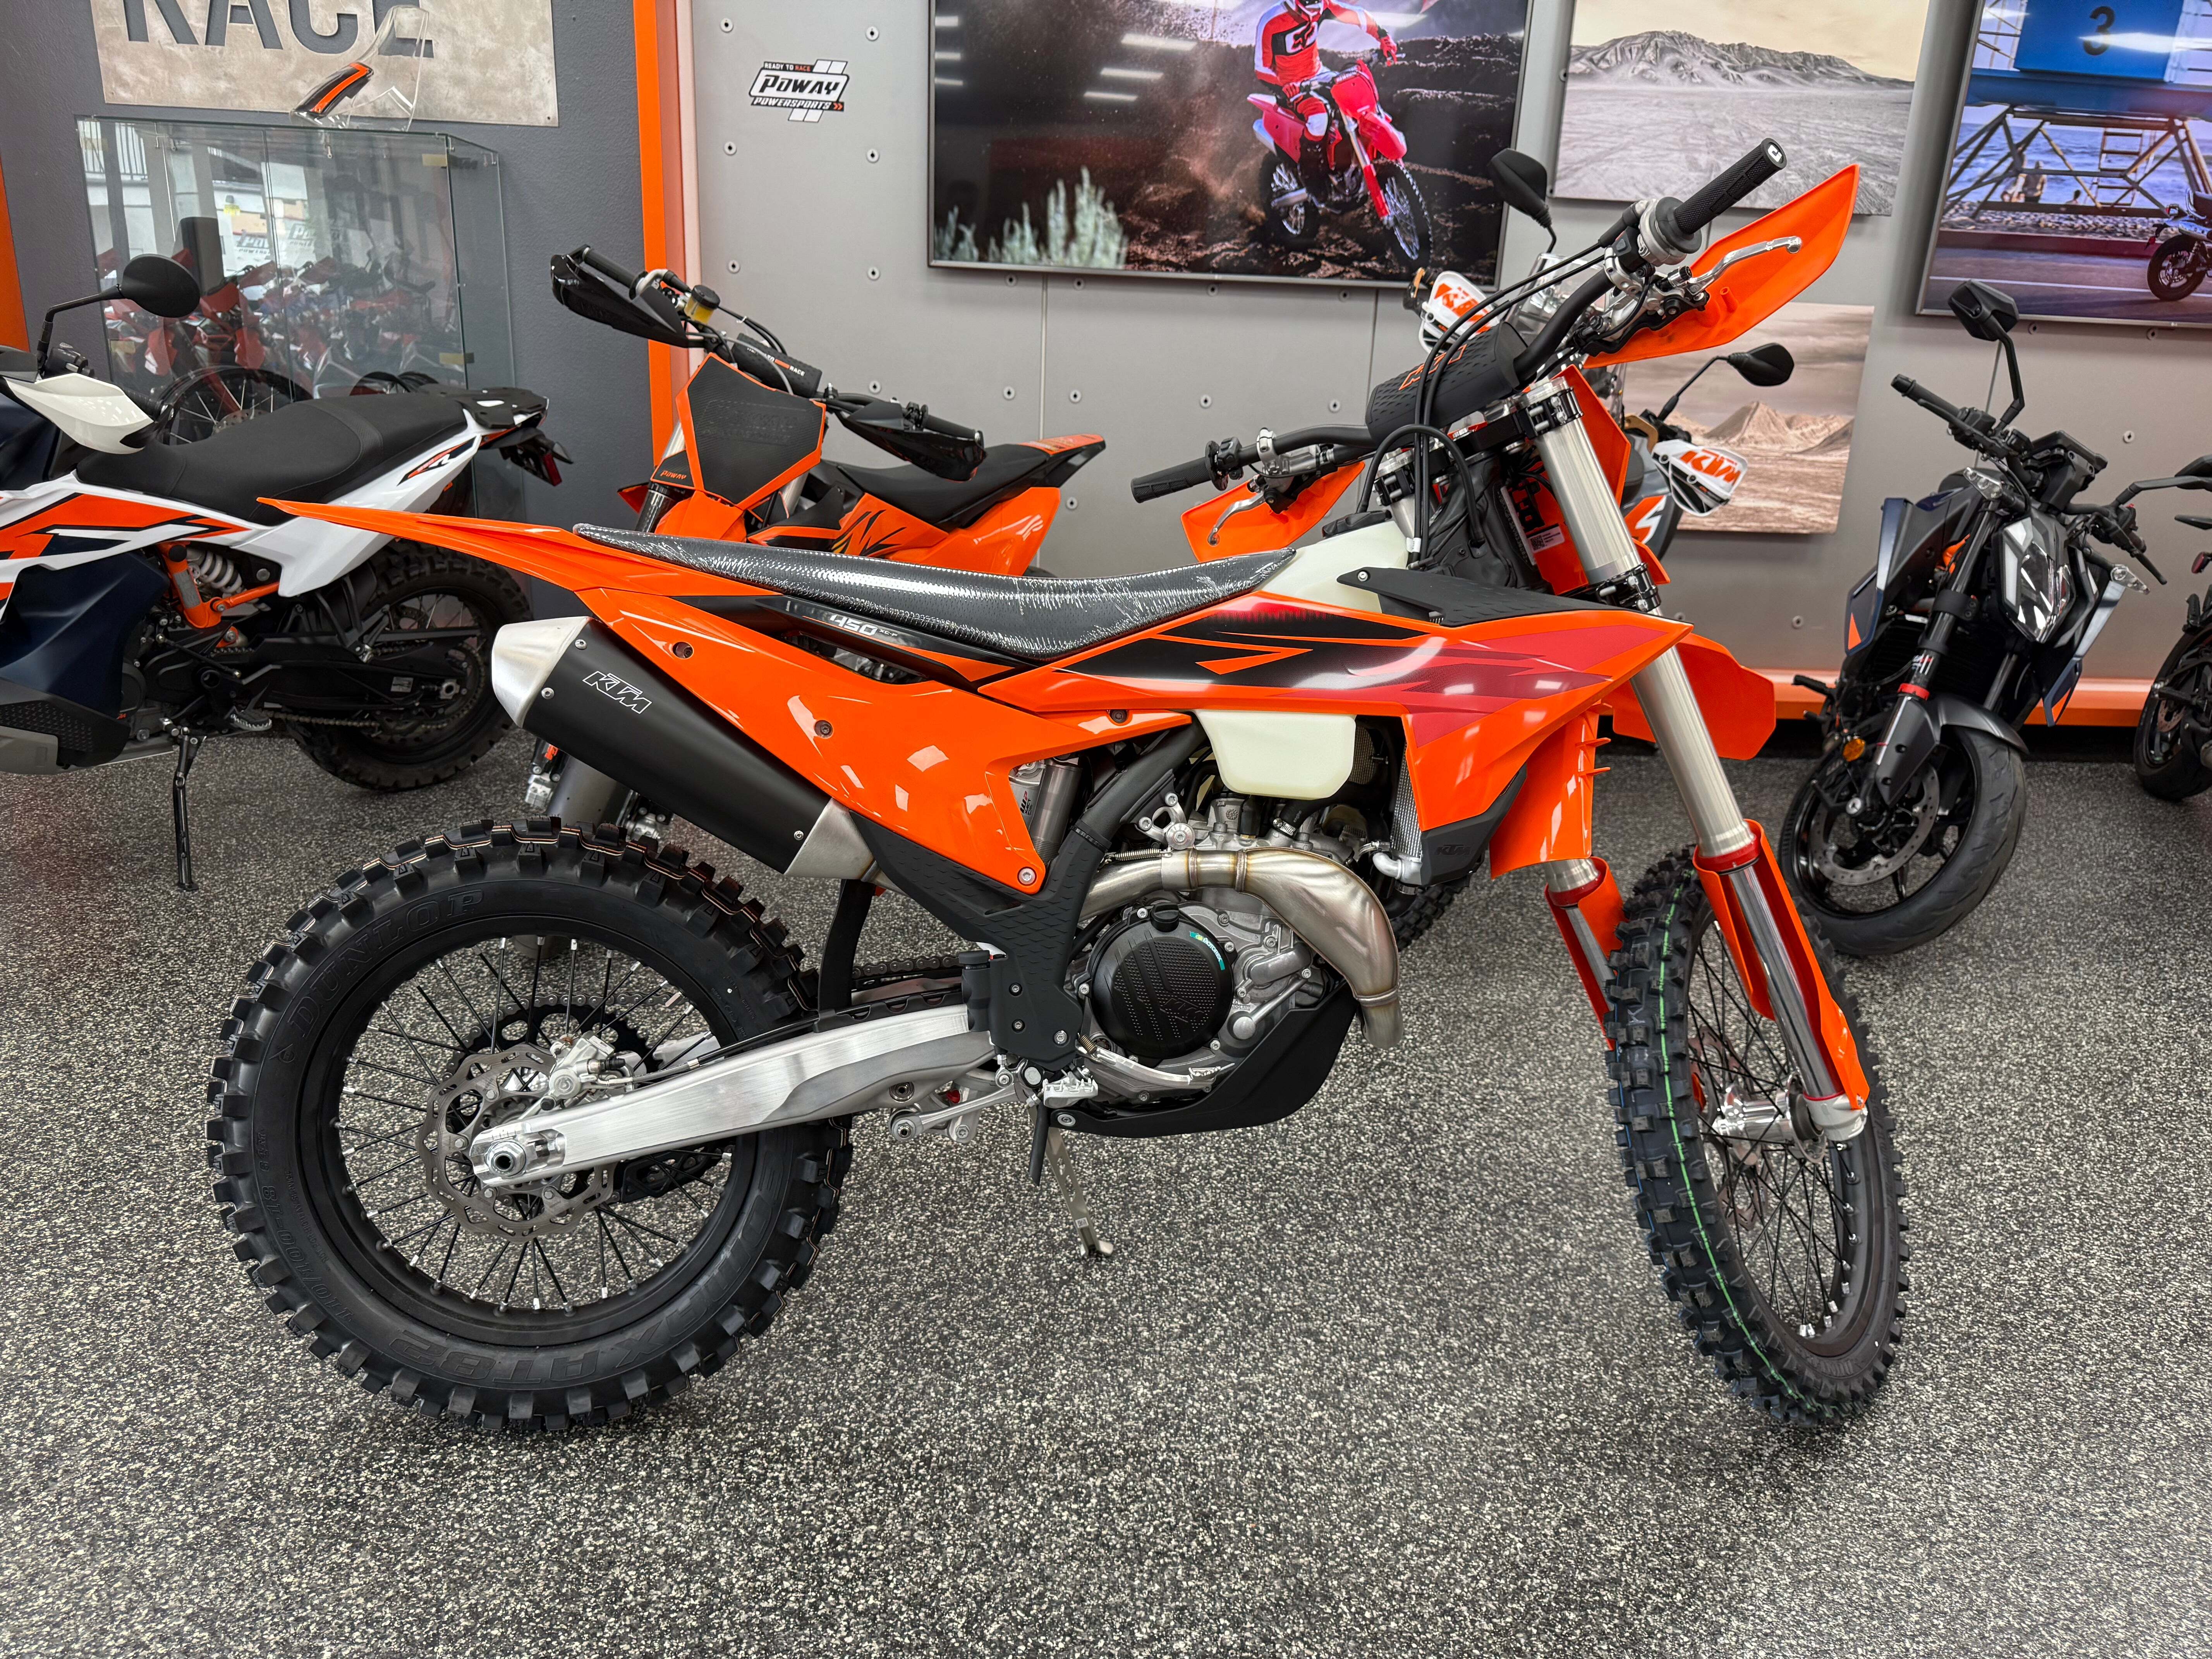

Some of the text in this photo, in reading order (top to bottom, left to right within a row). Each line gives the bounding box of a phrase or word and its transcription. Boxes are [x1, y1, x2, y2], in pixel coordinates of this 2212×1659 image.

[2083, 6, 2115, 55] 3
[759, 74, 840, 94] POWAY
[754, 97, 832, 109] POWERSPORTS
[789, 365, 805, 377] RACE
[1680, 448, 1741, 486] KTM
[830, 614, 898, 637] 450 XC-F
[582, 670, 653, 714] KTM
[1020, 790, 1028, 814] WP
[1435, 844, 1472, 855] KTM
[1202, 937, 1223, 962] MOTOREX
[285, 888, 485, 1039] DUNLOP
[261, 1183, 355, 1325] 110/100-18
